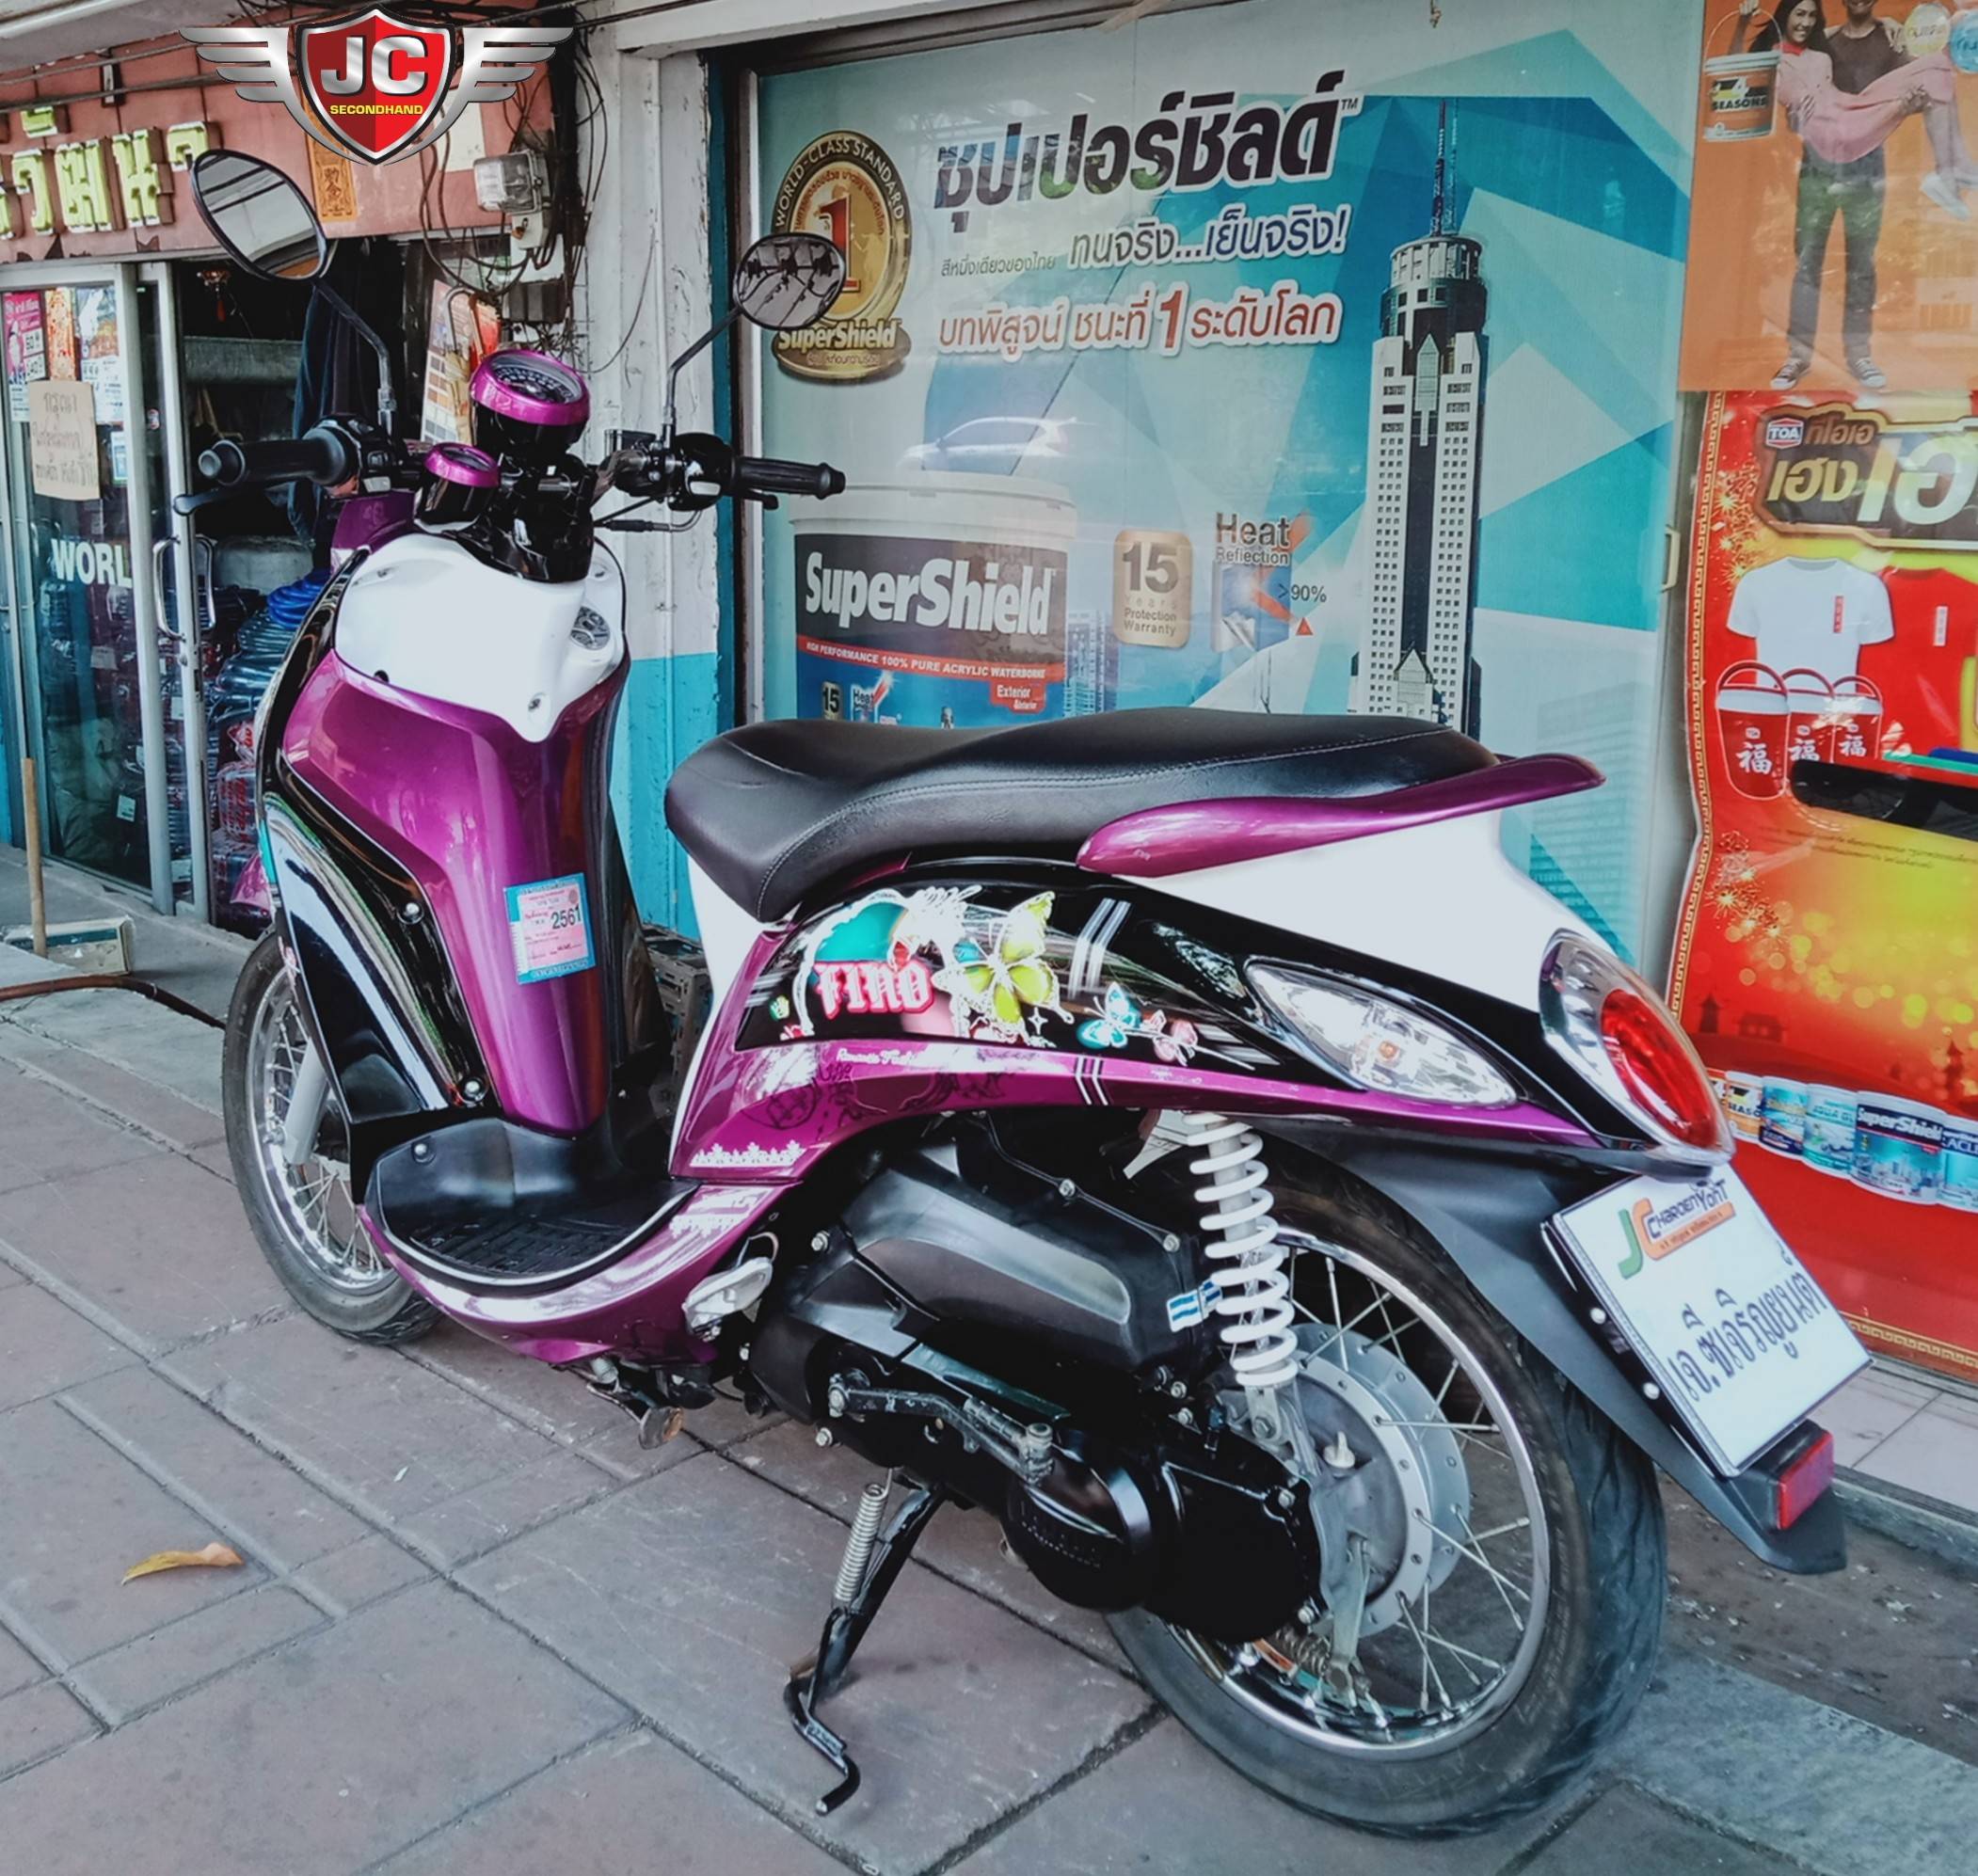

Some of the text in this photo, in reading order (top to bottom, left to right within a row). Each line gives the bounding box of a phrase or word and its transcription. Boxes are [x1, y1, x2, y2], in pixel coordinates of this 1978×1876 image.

[853, 140, 905, 220] STANDARD
[1160, 290, 1183, 348] 1
[1190, 288, 1336, 341] ระดับโลก
[778, 319, 897, 353] SuperShield
[1769, 427, 1801, 440] TOA
[1216, 512, 1290, 548] Heat
[51, 537, 133, 589] WORL
[1123, 541, 1179, 594] 15
[1215, 546, 1289, 565] Reflection
[806, 551, 1050, 636] SuperShield
[1124, 621, 1176, 638] Warranty
[1125, 608, 1176, 623] Protection
[820, 644, 879, 664] PERFORMANCE
[911, 659, 940, 672] PURE
[943, 662, 989, 677] ACRYLIC
[823, 686, 840, 713] 15
[1736, 741, 1773, 775] 福
[1838, 734, 1868, 757] 福
[550, 903, 582, 930] 2561
[812, 962, 933, 1019] FINO
[1858, 1106, 1943, 1141] SuperShield
